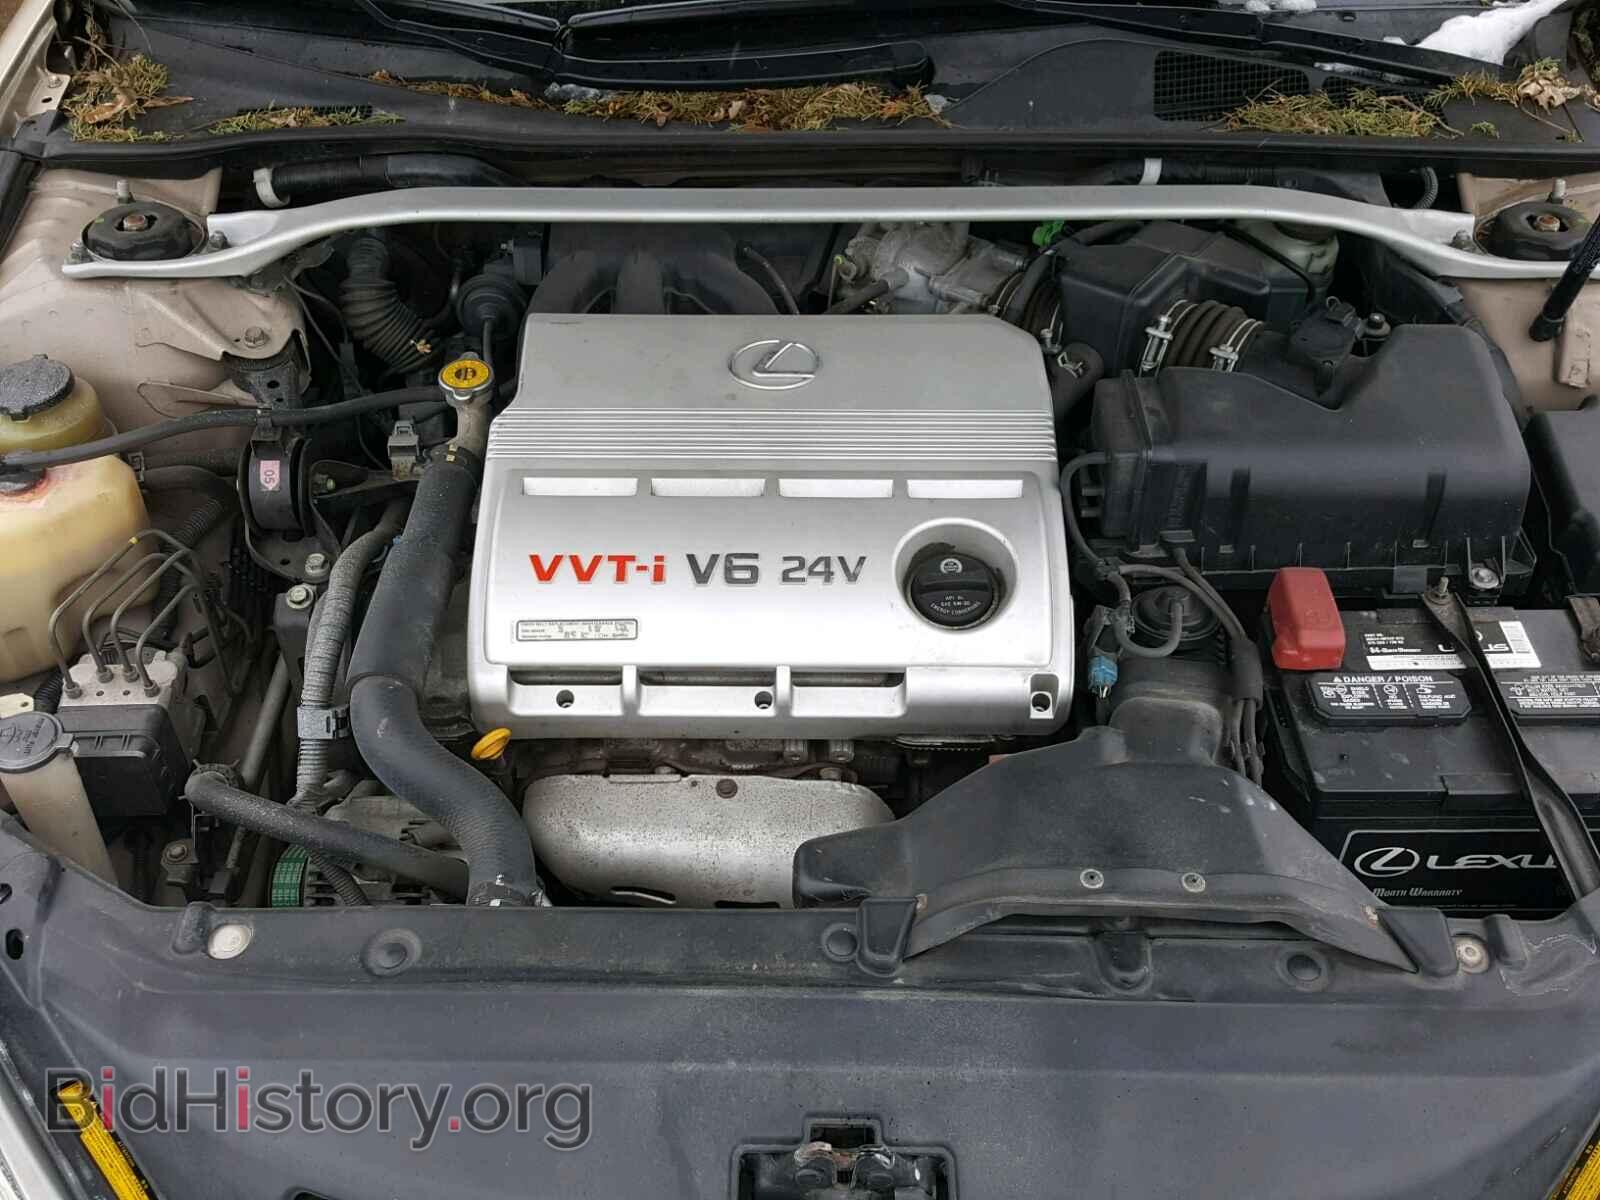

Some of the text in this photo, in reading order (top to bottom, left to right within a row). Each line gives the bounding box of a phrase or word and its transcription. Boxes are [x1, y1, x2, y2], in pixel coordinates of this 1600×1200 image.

[529, 552, 867, 585] VVT-i V6 24V
[1426, 854, 1557, 869] LEXU
